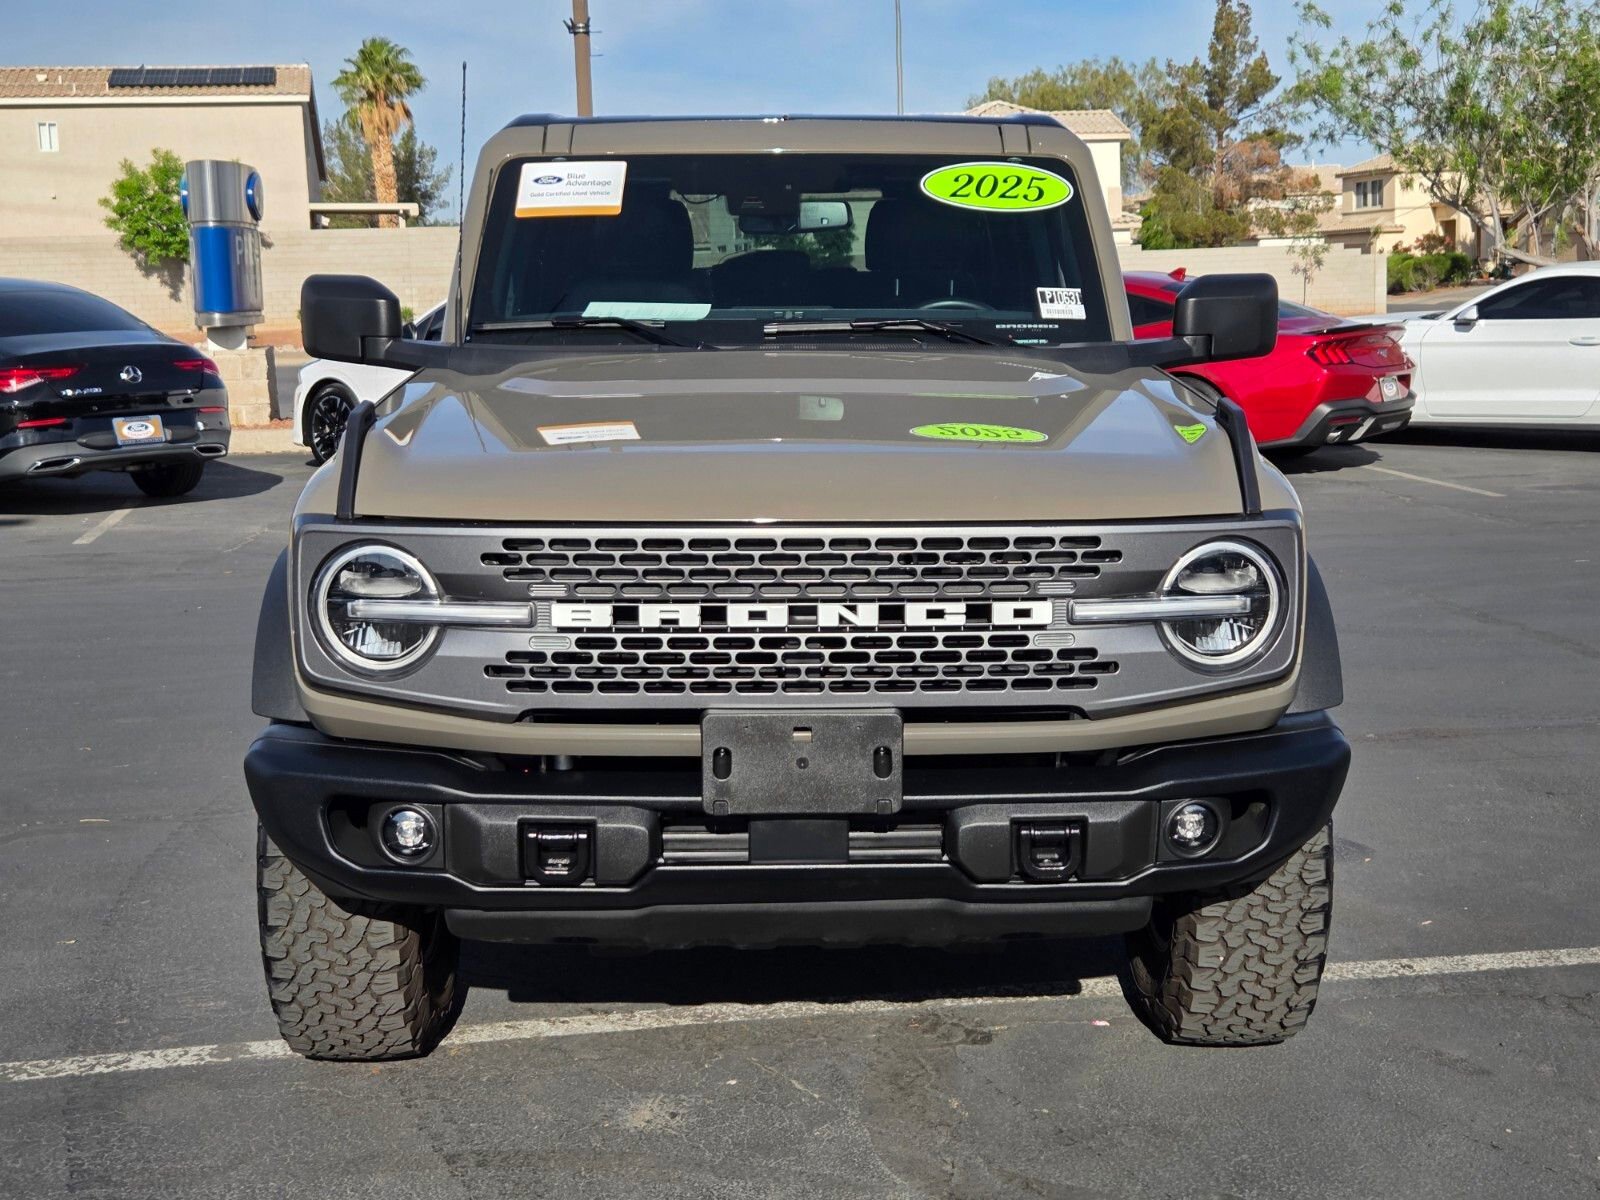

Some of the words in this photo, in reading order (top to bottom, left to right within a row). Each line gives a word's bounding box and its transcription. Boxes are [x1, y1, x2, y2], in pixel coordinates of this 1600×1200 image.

[949, 173, 1047, 202] 2025
[1045, 290, 1082, 305] P10631
[550, 600, 1053, 628] BRONCO
